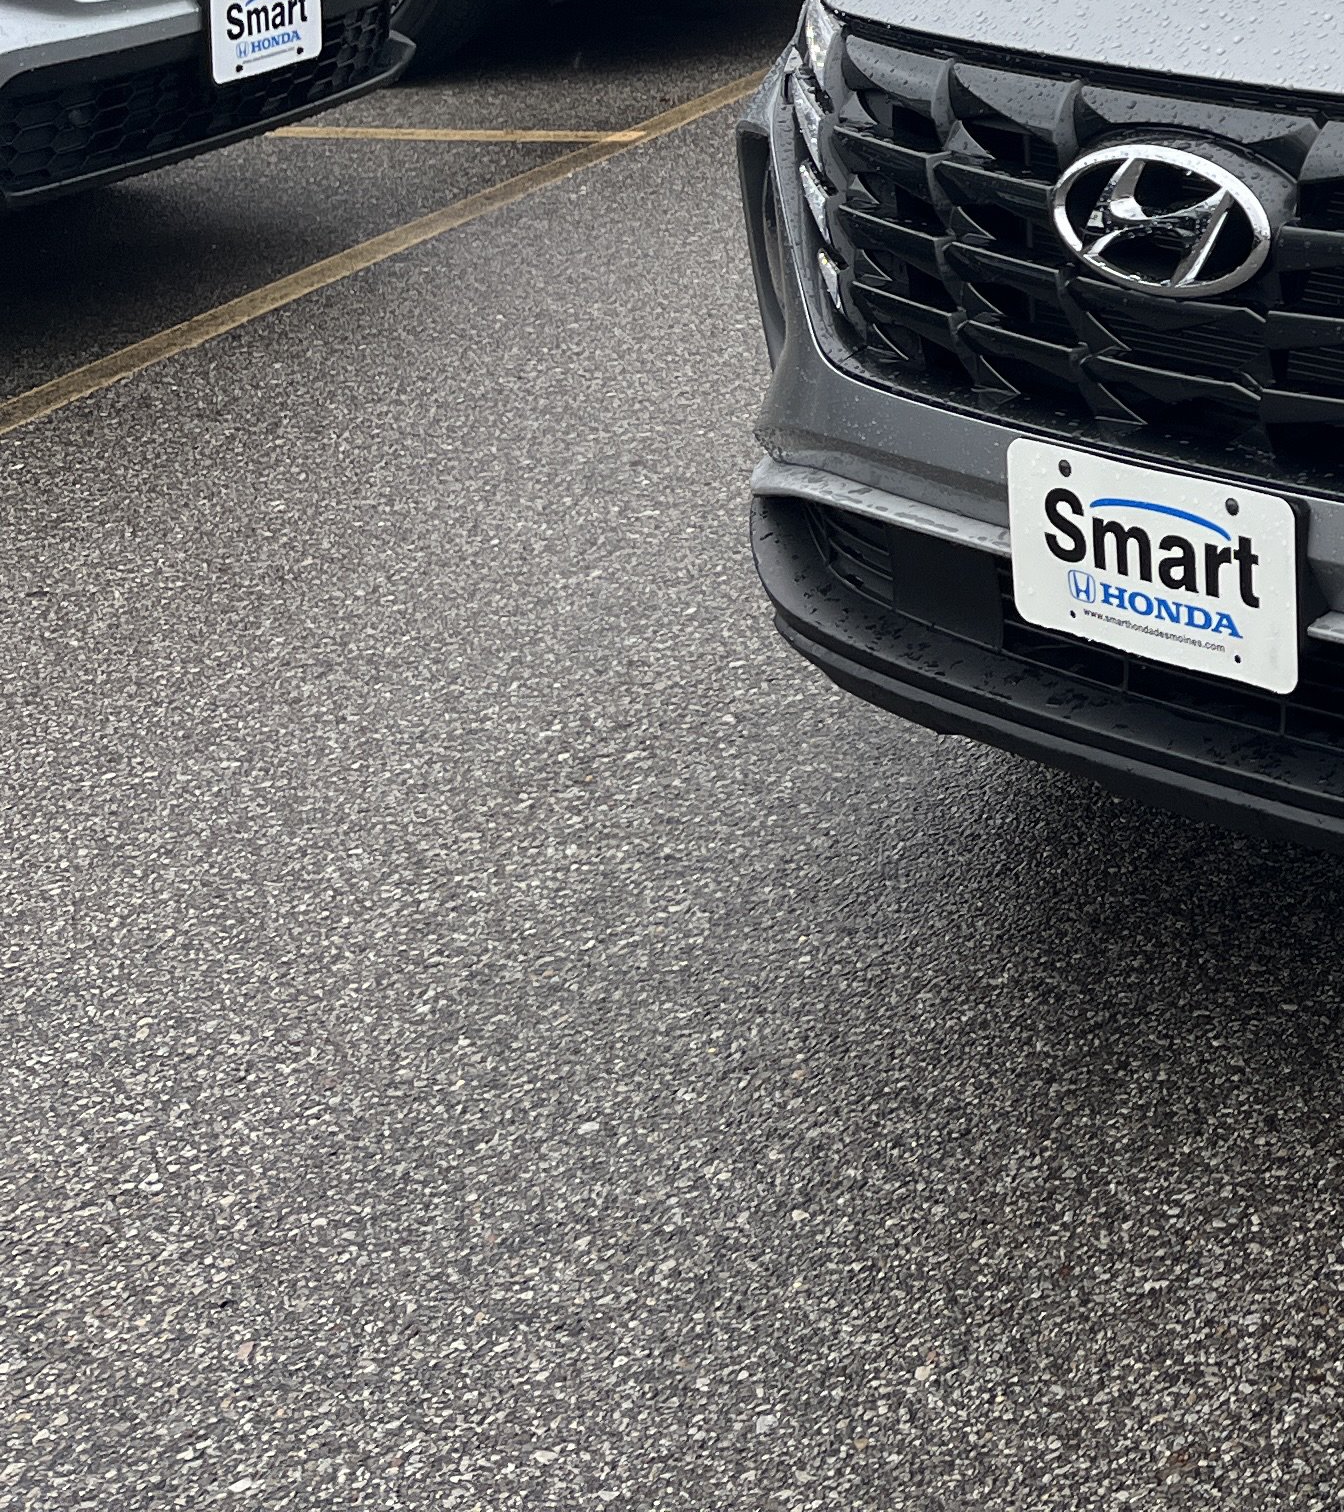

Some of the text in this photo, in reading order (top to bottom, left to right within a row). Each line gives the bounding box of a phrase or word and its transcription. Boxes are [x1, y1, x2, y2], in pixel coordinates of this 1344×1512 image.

[250, 29, 302, 54] HONDA
[1043, 487, 1261, 609] Smart
[1083, 608, 1226, 653] www.smarthondadesmoines.com
[1099, 582, 1244, 639] HONDA
